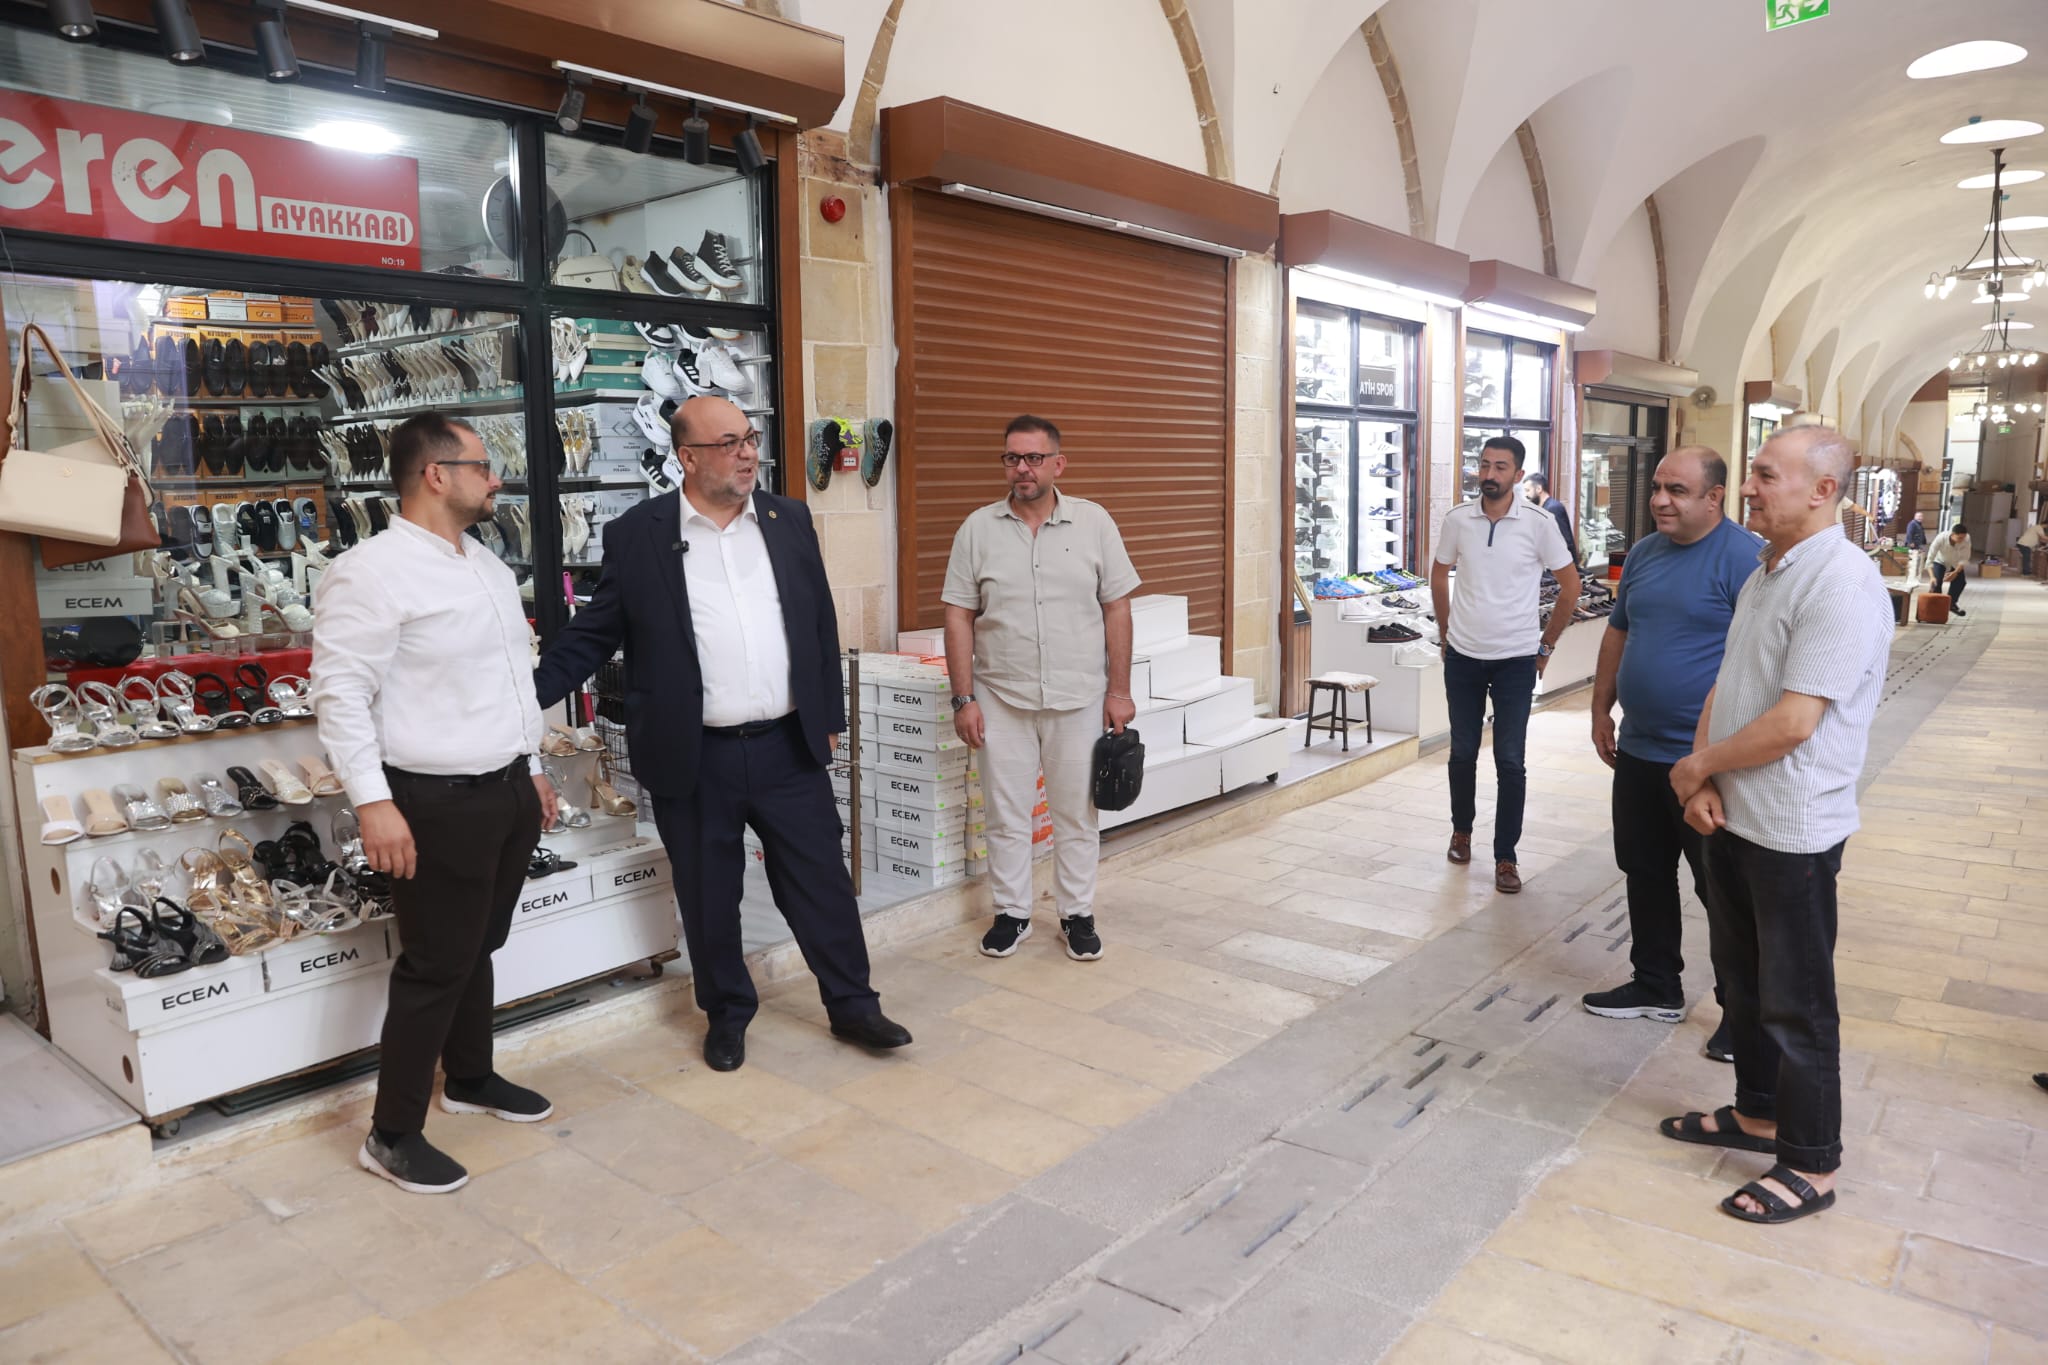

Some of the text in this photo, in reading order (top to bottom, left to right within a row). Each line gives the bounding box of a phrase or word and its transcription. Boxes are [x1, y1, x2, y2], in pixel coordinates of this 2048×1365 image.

[271, 202, 406, 242] AYAKKABI
[381, 257, 405, 267] NO:19
[1376, 382, 1394, 397] SPOR
[65, 597, 123, 609] ECEM
[893, 694, 922, 705] ECEM
[893, 723, 922, 735] ECEM
[894, 751, 923, 764] ECEM
[891, 781, 920, 793] ECEM
[892, 809, 921, 822] ECEM
[891, 836, 919, 850] ECEM
[614, 867, 657, 886] ECEM
[892, 863, 920, 877] ECEM
[521, 891, 568, 913] ECEM
[300, 948, 359, 973] ECEM
[161, 981, 229, 1010] ECEM
